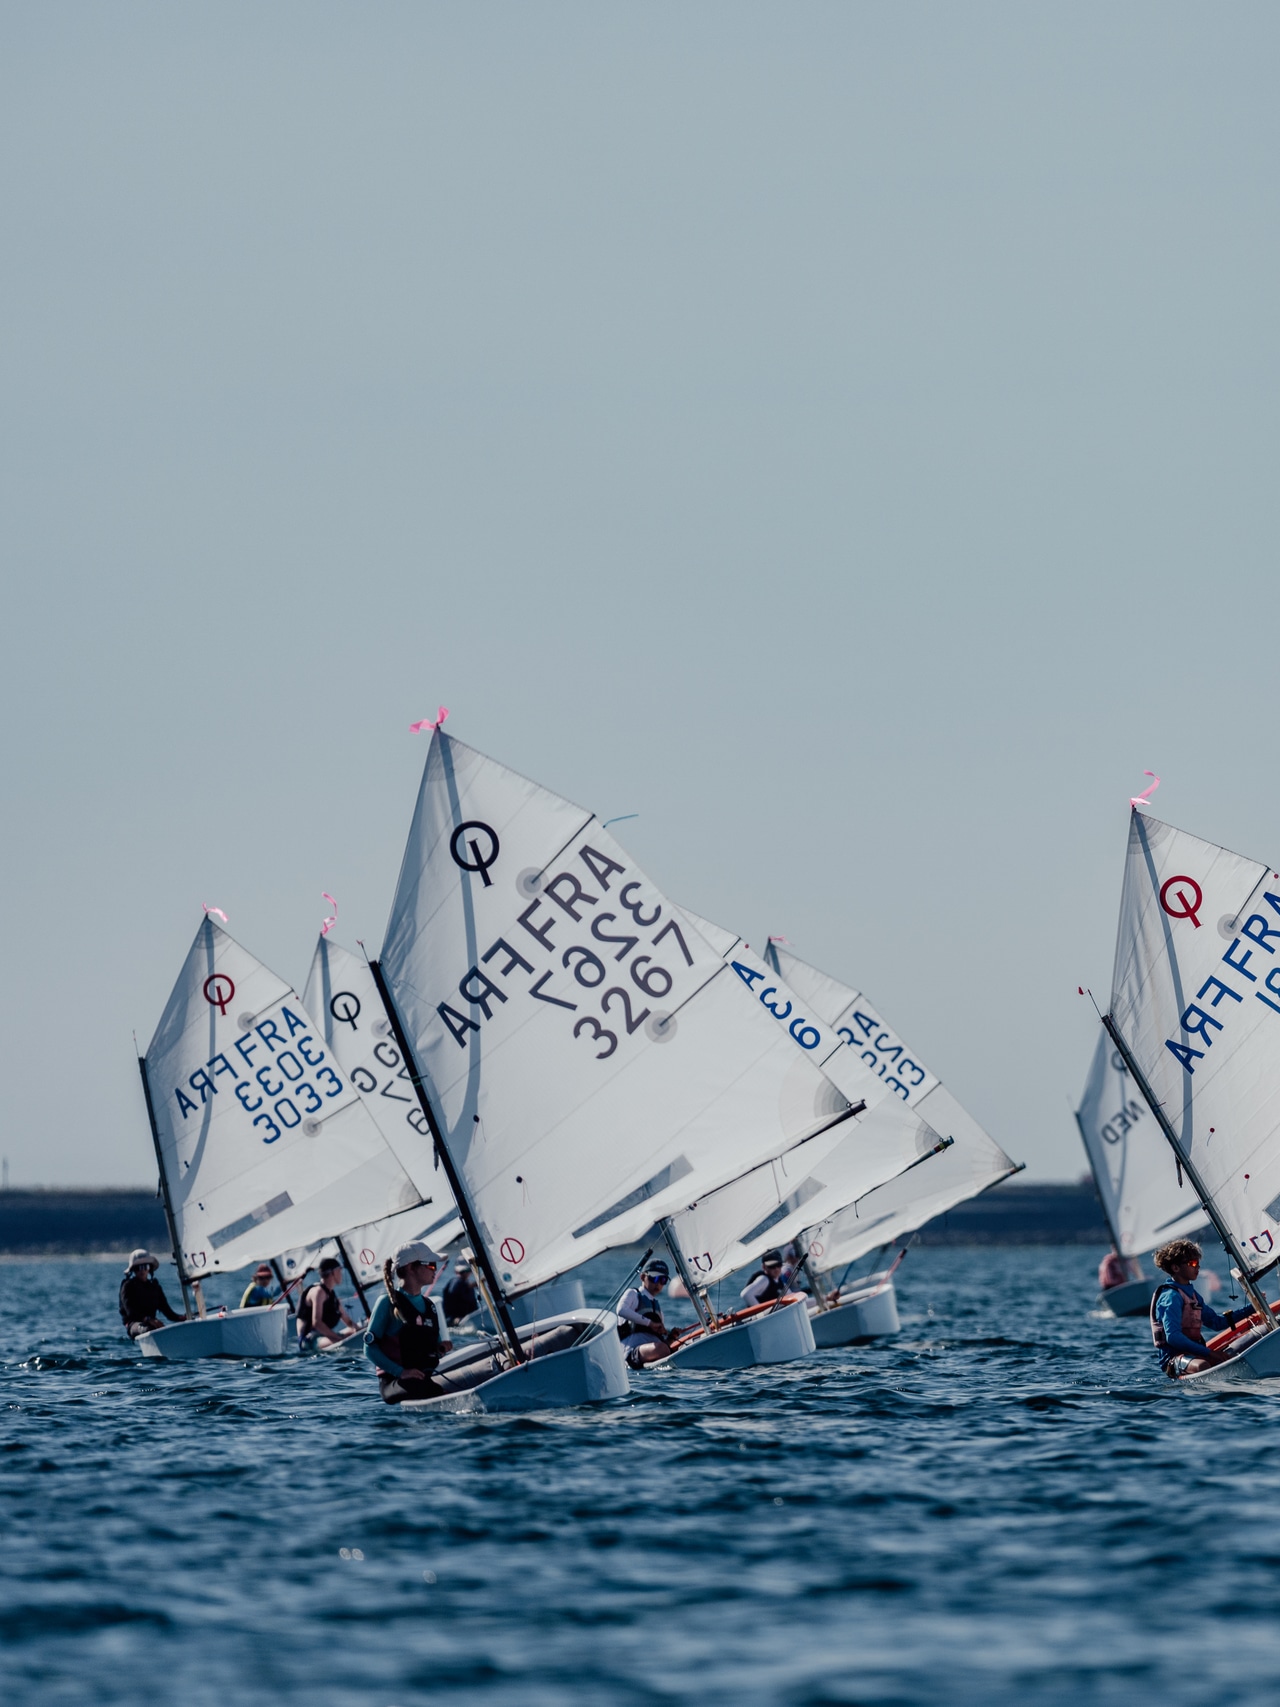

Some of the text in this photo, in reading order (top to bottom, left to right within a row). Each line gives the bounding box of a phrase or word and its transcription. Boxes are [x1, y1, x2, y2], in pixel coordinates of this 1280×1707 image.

[517, 844, 626, 953] FRA
[573, 919, 694, 1060] 3267
[234, 1006, 307, 1068] FRA
[837, 1011, 880, 1046] RA
[253, 1067, 343, 1144] 3033
